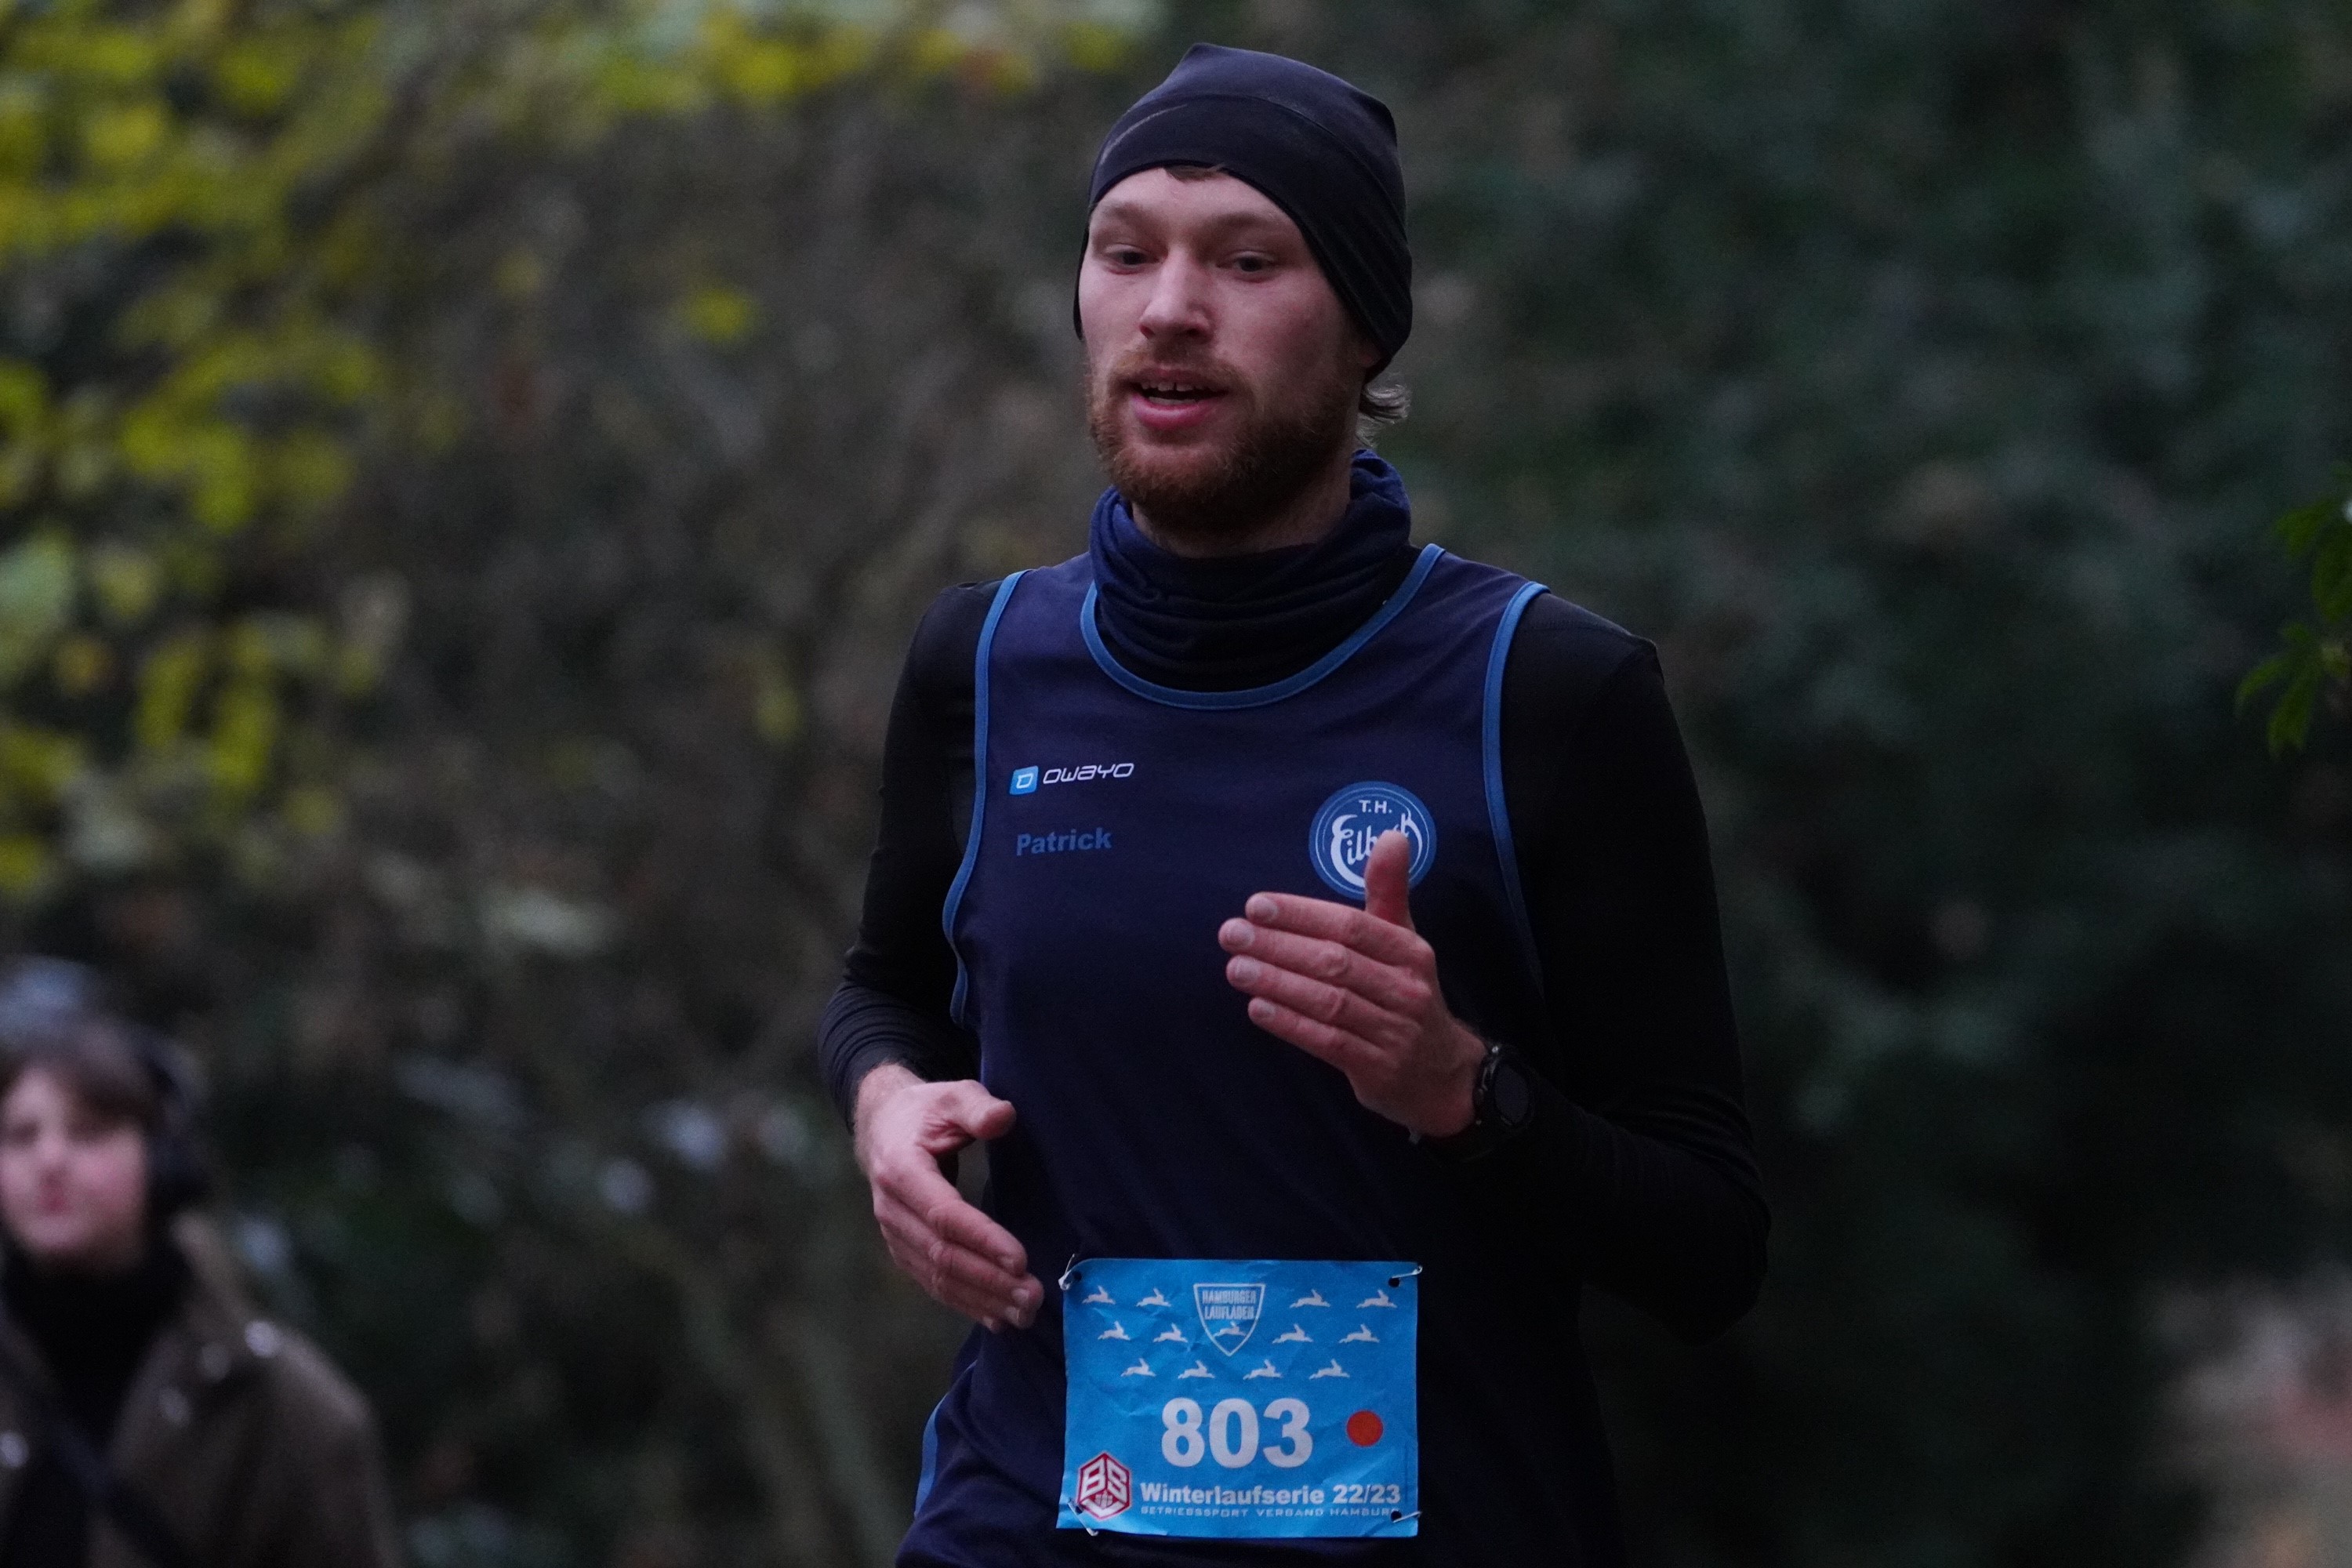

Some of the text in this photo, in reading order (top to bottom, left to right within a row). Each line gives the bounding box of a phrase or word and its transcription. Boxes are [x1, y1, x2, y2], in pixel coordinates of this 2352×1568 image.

[1359, 800, 1392, 814] T.H.
[1017, 827, 1112, 856] Patrick
[1202, 1290, 1256, 1304] HAMBURGER
[1204, 1305, 1254, 1320] LAUFLADEN
[1161, 1397, 1313, 1468] 803
[1140, 1482, 1401, 1505] Winterlaufserie 22/23
[1141, 1505, 1249, 1518] BETRIEBSSPORT
[1257, 1508, 1324, 1518] VERBAND
